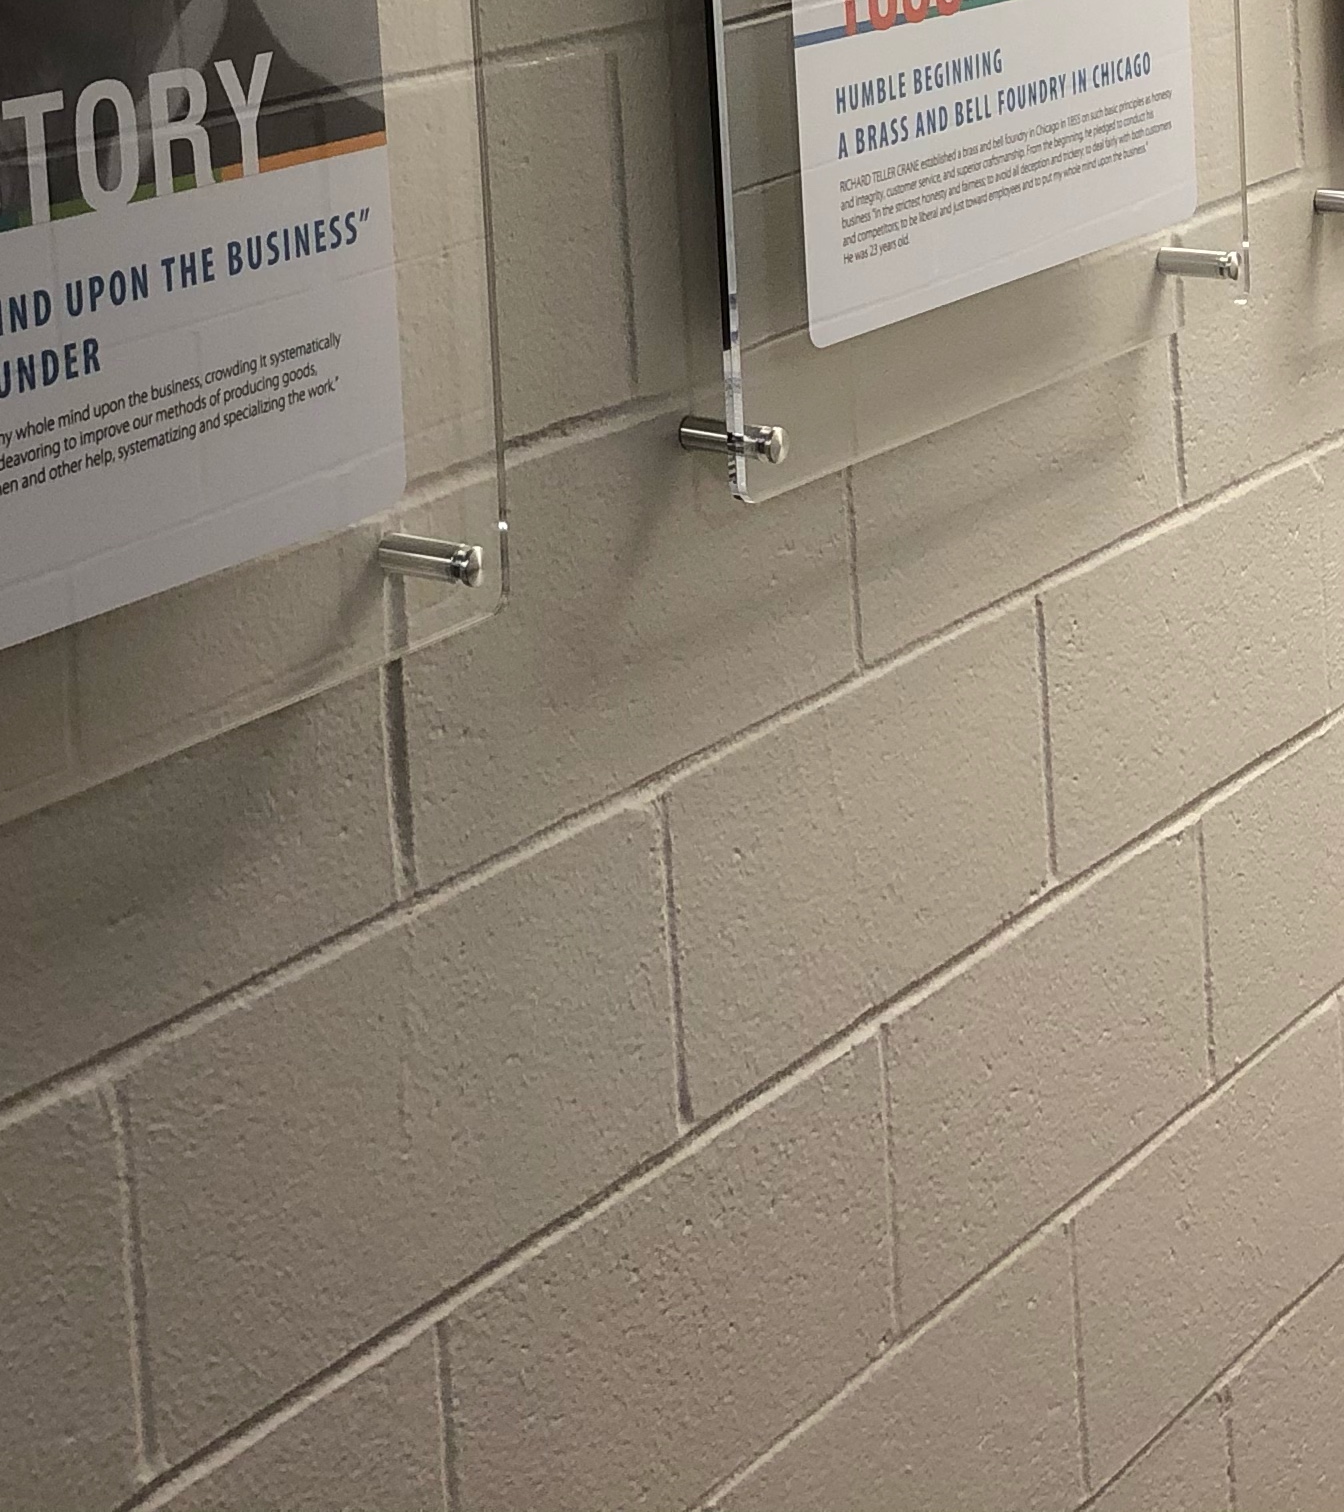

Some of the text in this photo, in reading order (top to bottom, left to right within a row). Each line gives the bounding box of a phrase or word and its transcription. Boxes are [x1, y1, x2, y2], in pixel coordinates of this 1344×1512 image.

[835, 48, 1002, 114] HUMBLE BEGINNING
[837, 51, 1150, 160] A BRASS AND BELL FOUNDRY IN CHICAGO
[839, 173, 871, 192] RICHARD
[871, 166, 896, 183] TELLER
[896, 159, 919, 177] CRANE
[65, 263, 148, 317] UPON
[160, 246, 215, 292] THE
[227, 207, 369, 276] BUSINESS"
[843, 253, 854, 264] He
[854, 248, 868, 260] was
[869, 243, 878, 257] 23
[878, 239, 897, 256] years
[15, 416, 55, 440] whole
[57, 403, 90, 428] mind
[92, 397, 126, 419] upon
[127, 390, 148, 407] the
[150, 375, 203, 401] business,
[204, 358, 257, 385] crowding
[259, 354, 267, 368] it
[269, 333, 341, 368] systematically
[63, 436, 77, 451] to
[79, 420, 130, 446] improve
[132, 413, 153, 430] our
[155, 396, 207, 422] methods
[209, 390, 221, 407] of
[223, 375, 279, 406] producing
[281, 364, 317, 388] goods,
[21, 467, 46, 489] and
[48, 458, 82, 480] other
[85, 449, 115, 469] help,
[117, 424, 196, 462] systematizing
[198, 414, 220, 434] and
[223, 396, 285, 428] specializing
[287, 390, 305, 405] the
